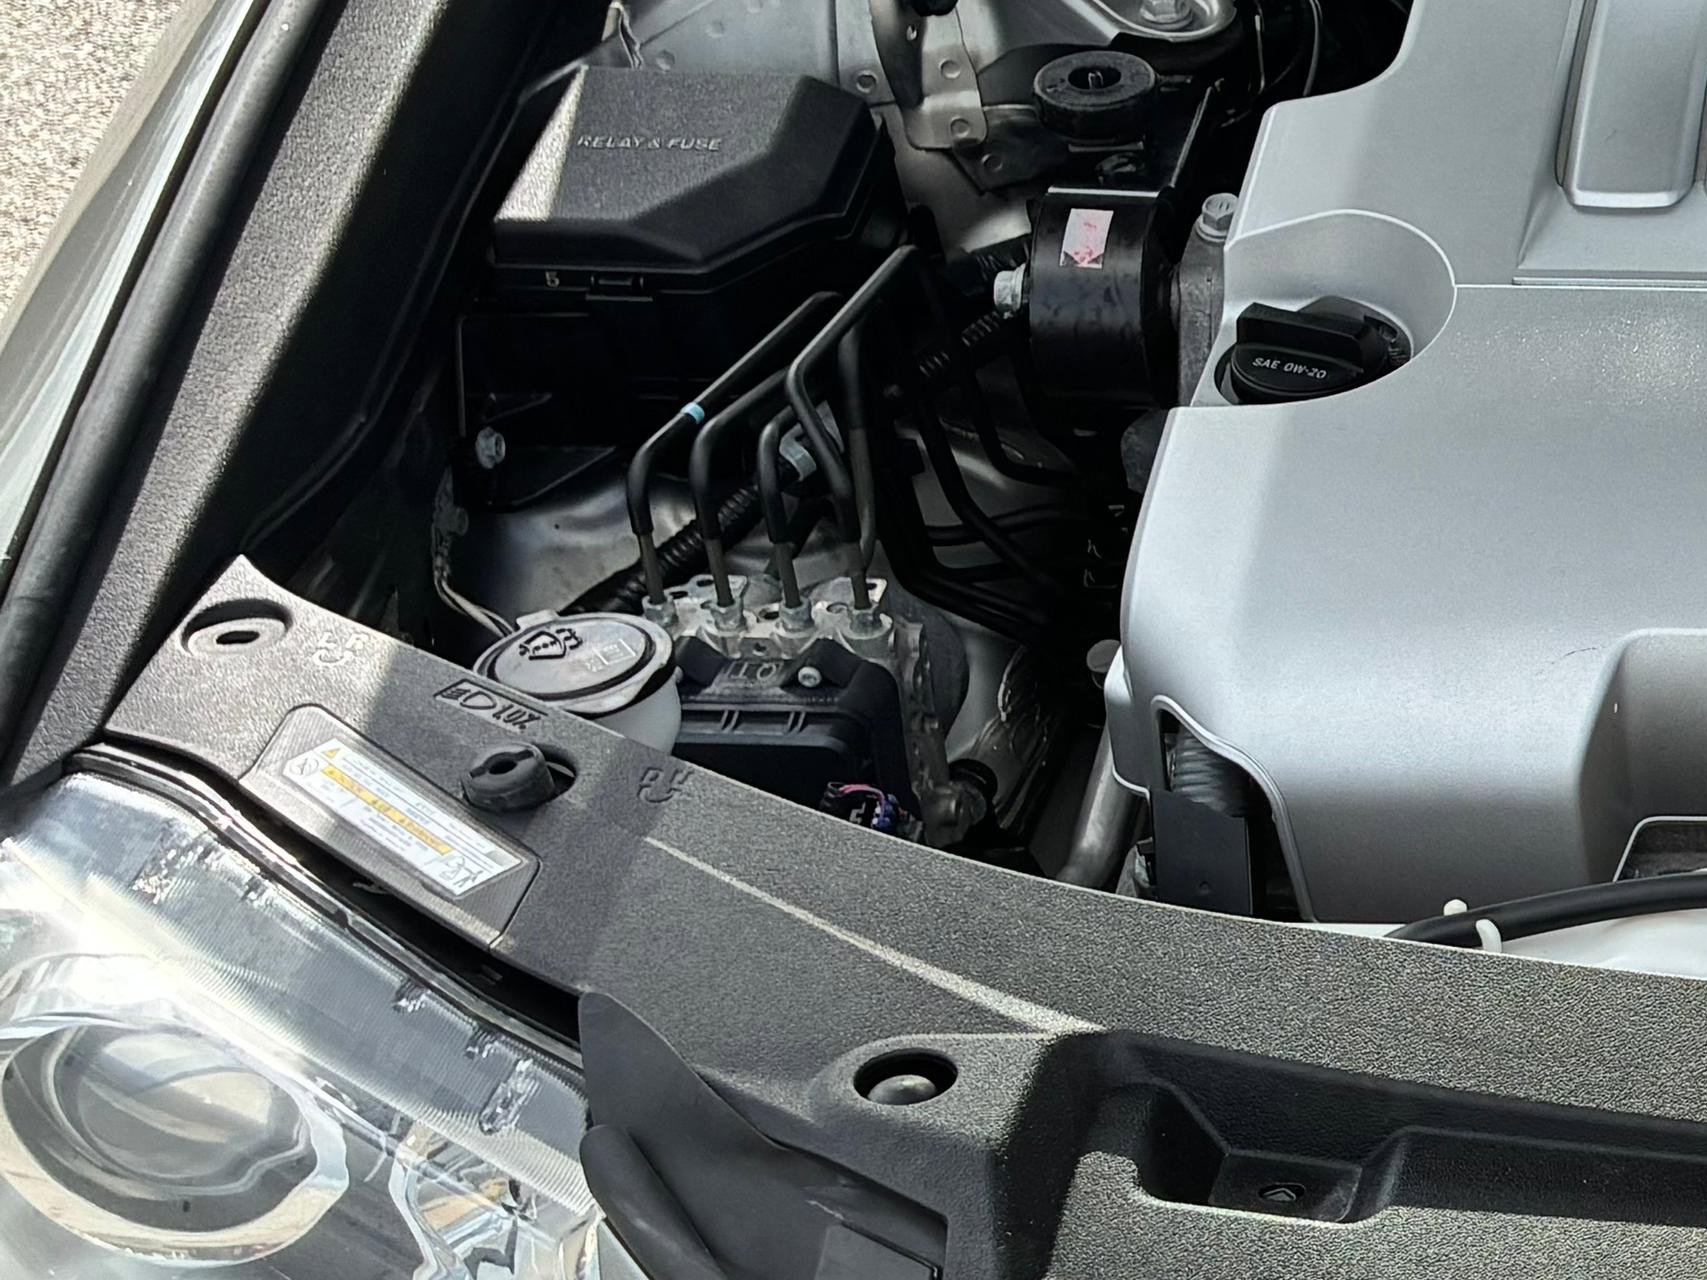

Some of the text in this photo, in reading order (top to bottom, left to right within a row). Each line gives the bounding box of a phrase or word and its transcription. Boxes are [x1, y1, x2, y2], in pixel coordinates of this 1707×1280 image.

[577, 135, 644, 149] RELAY
[667, 137, 721, 151] FUSE
[1252, 357, 1327, 379] SAE 0W-20
